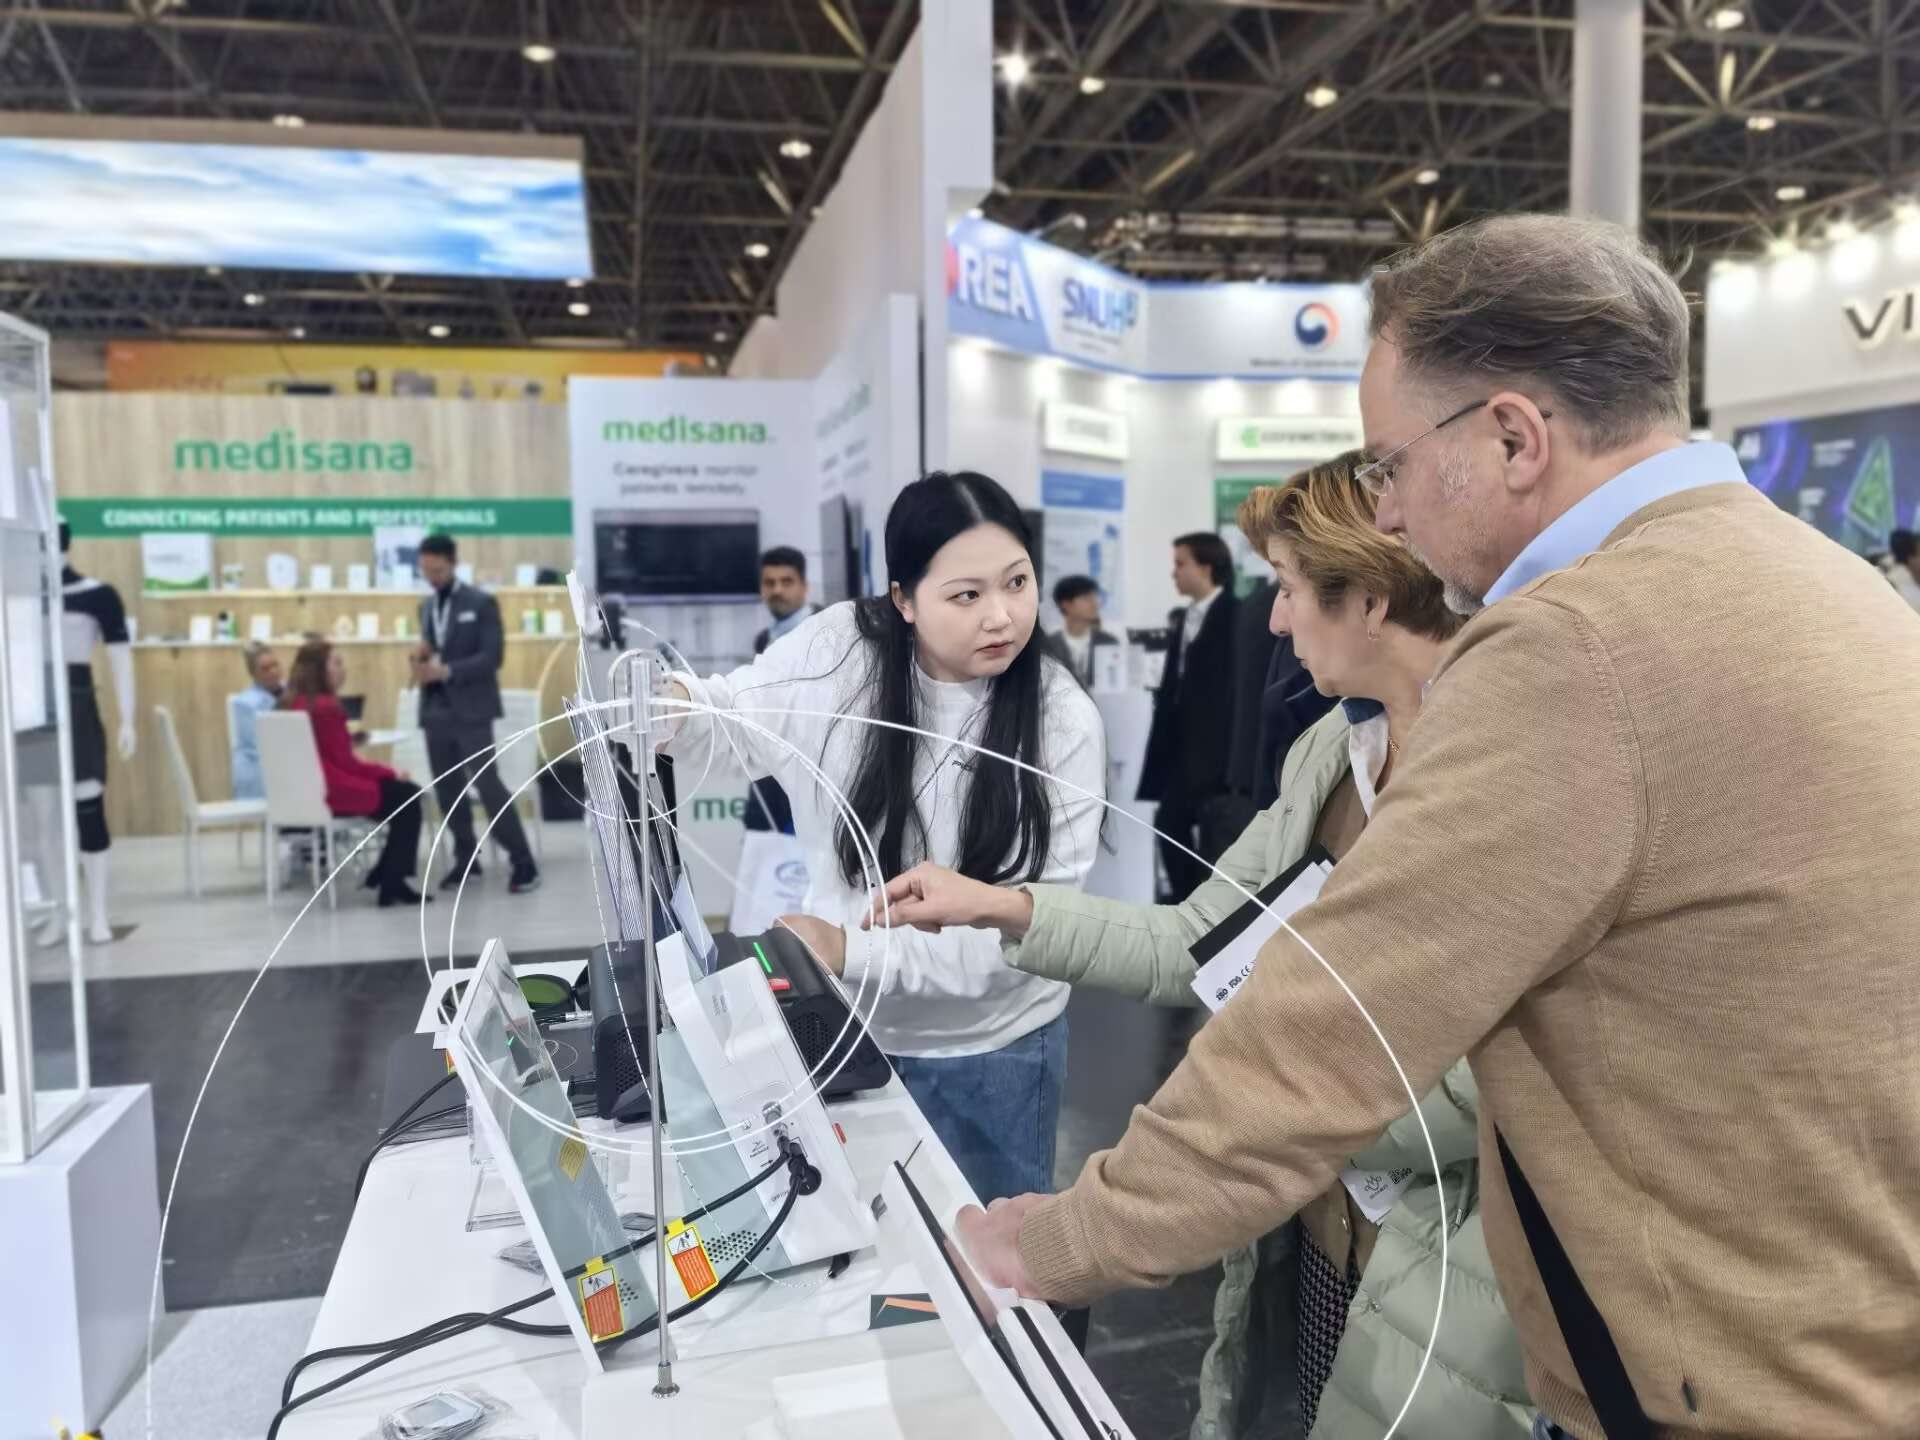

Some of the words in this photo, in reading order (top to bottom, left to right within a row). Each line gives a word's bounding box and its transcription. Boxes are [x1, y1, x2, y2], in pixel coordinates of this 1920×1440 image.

[603, 415, 768, 443] medisana
[175, 430, 413, 472] medisana
[102, 508, 222, 527] CONNECTING
[225, 508, 310, 527] PATIENTS
[313, 508, 352, 526] AND
[356, 508, 496, 527] PROFESSIONALS
[693, 797, 746, 821] me
